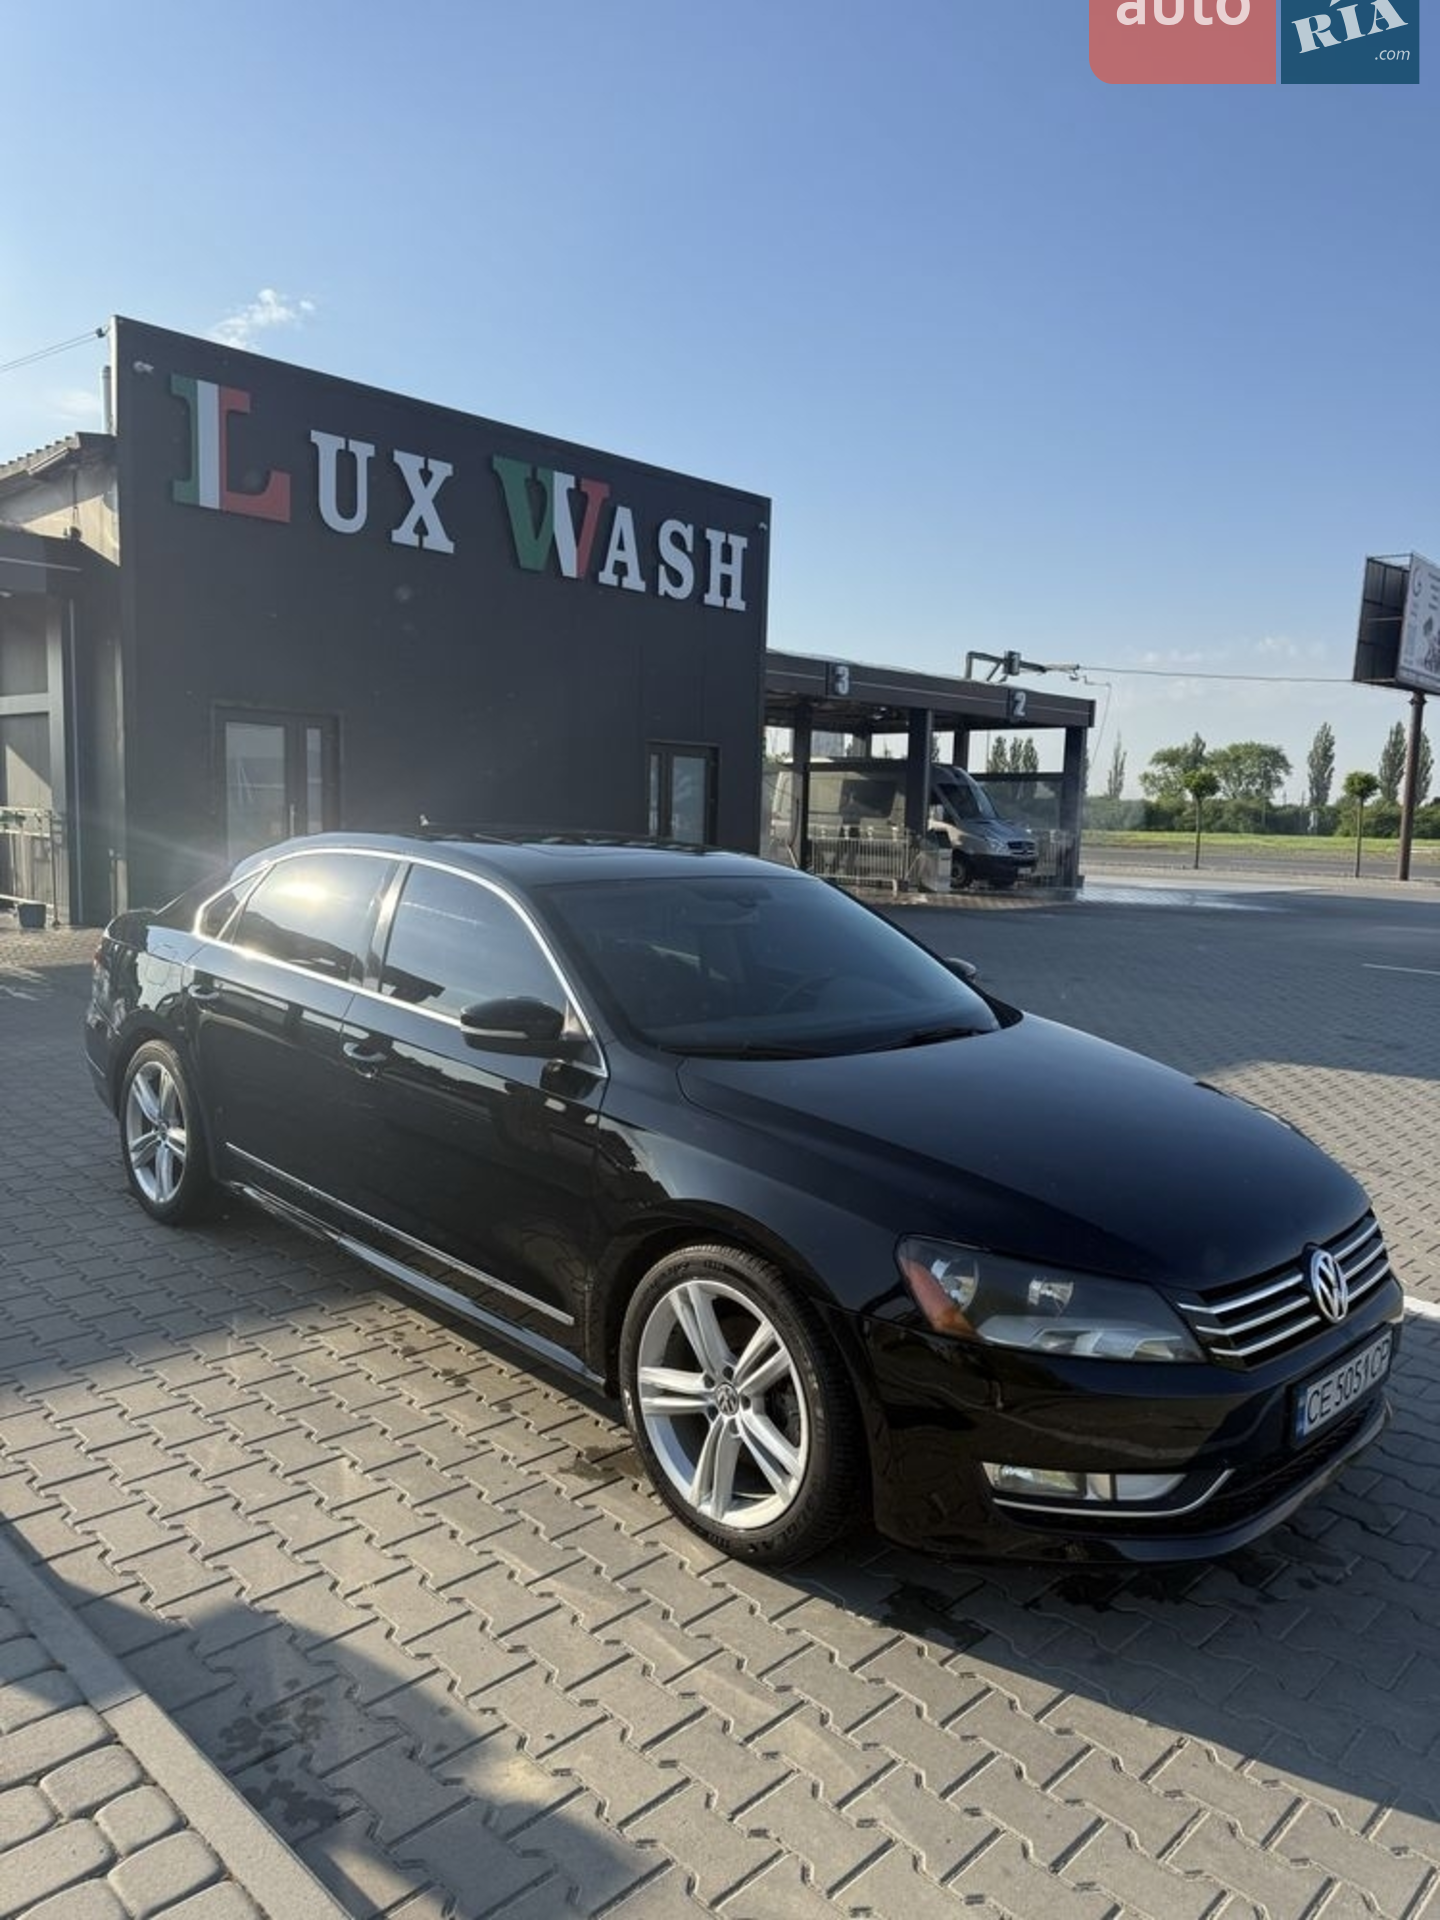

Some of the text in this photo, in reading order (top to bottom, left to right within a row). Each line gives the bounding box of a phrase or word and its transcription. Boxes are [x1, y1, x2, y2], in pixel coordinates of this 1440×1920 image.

[170, 373, 748, 612] LUX WASH
[836, 665, 849, 695] 3
[1013, 691, 1026, 717] 2
